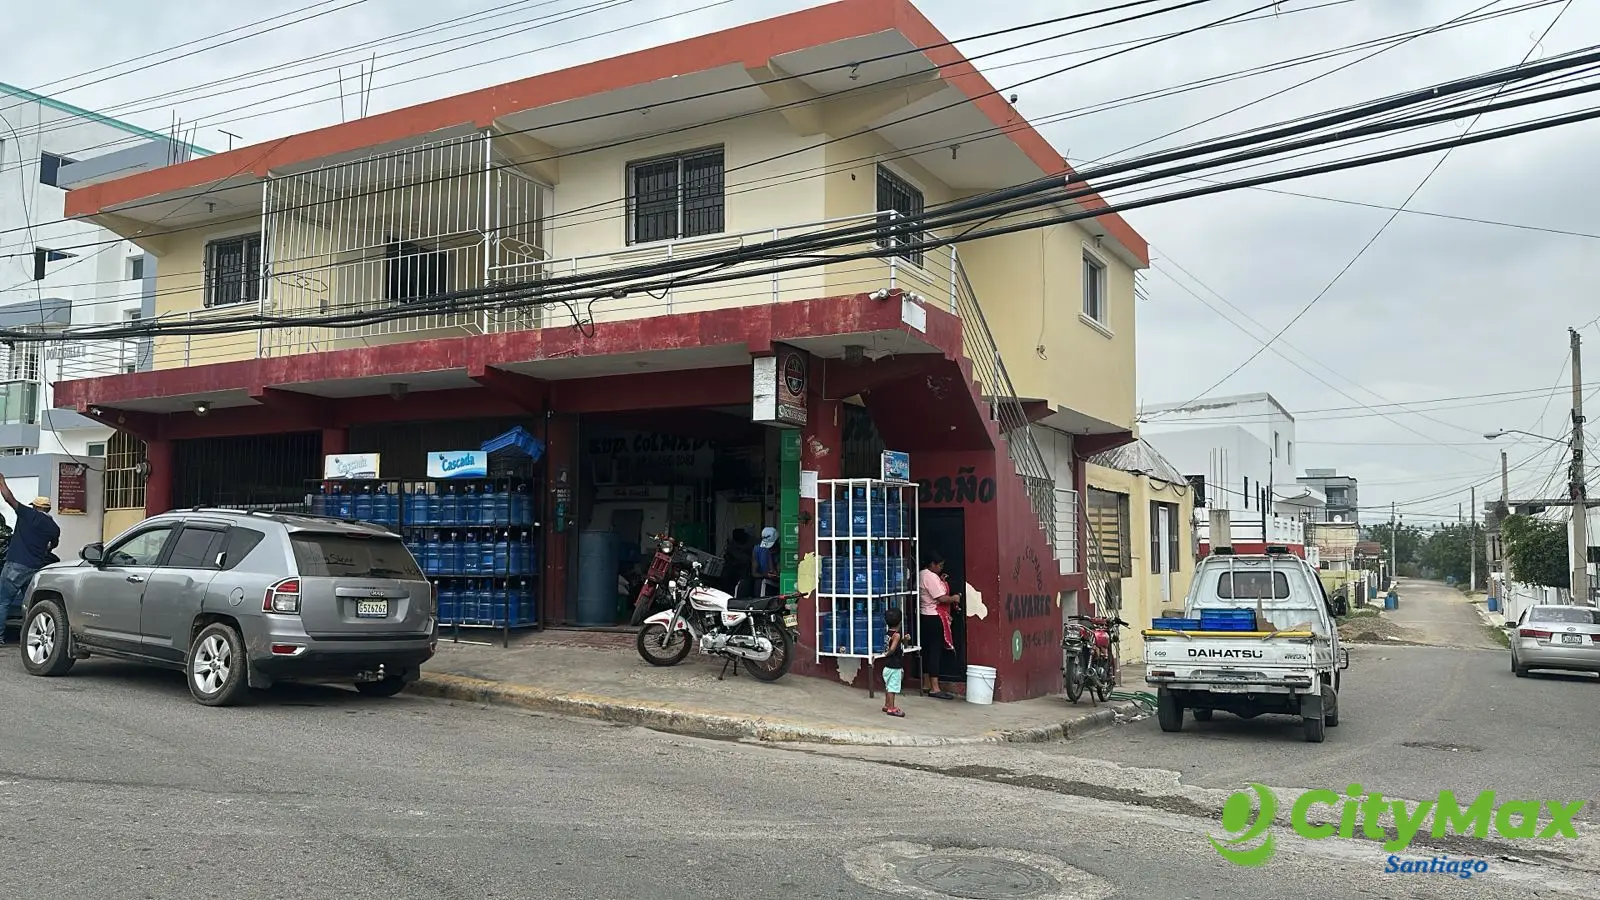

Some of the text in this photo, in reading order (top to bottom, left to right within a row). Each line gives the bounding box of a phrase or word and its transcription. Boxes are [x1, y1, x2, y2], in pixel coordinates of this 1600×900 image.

[337, 456, 367, 473] Cascada
[441, 453, 474, 472] Cascada
[918, 466, 996, 504] BAÑO
[1187, 649, 1264, 659] DAIHATSU
